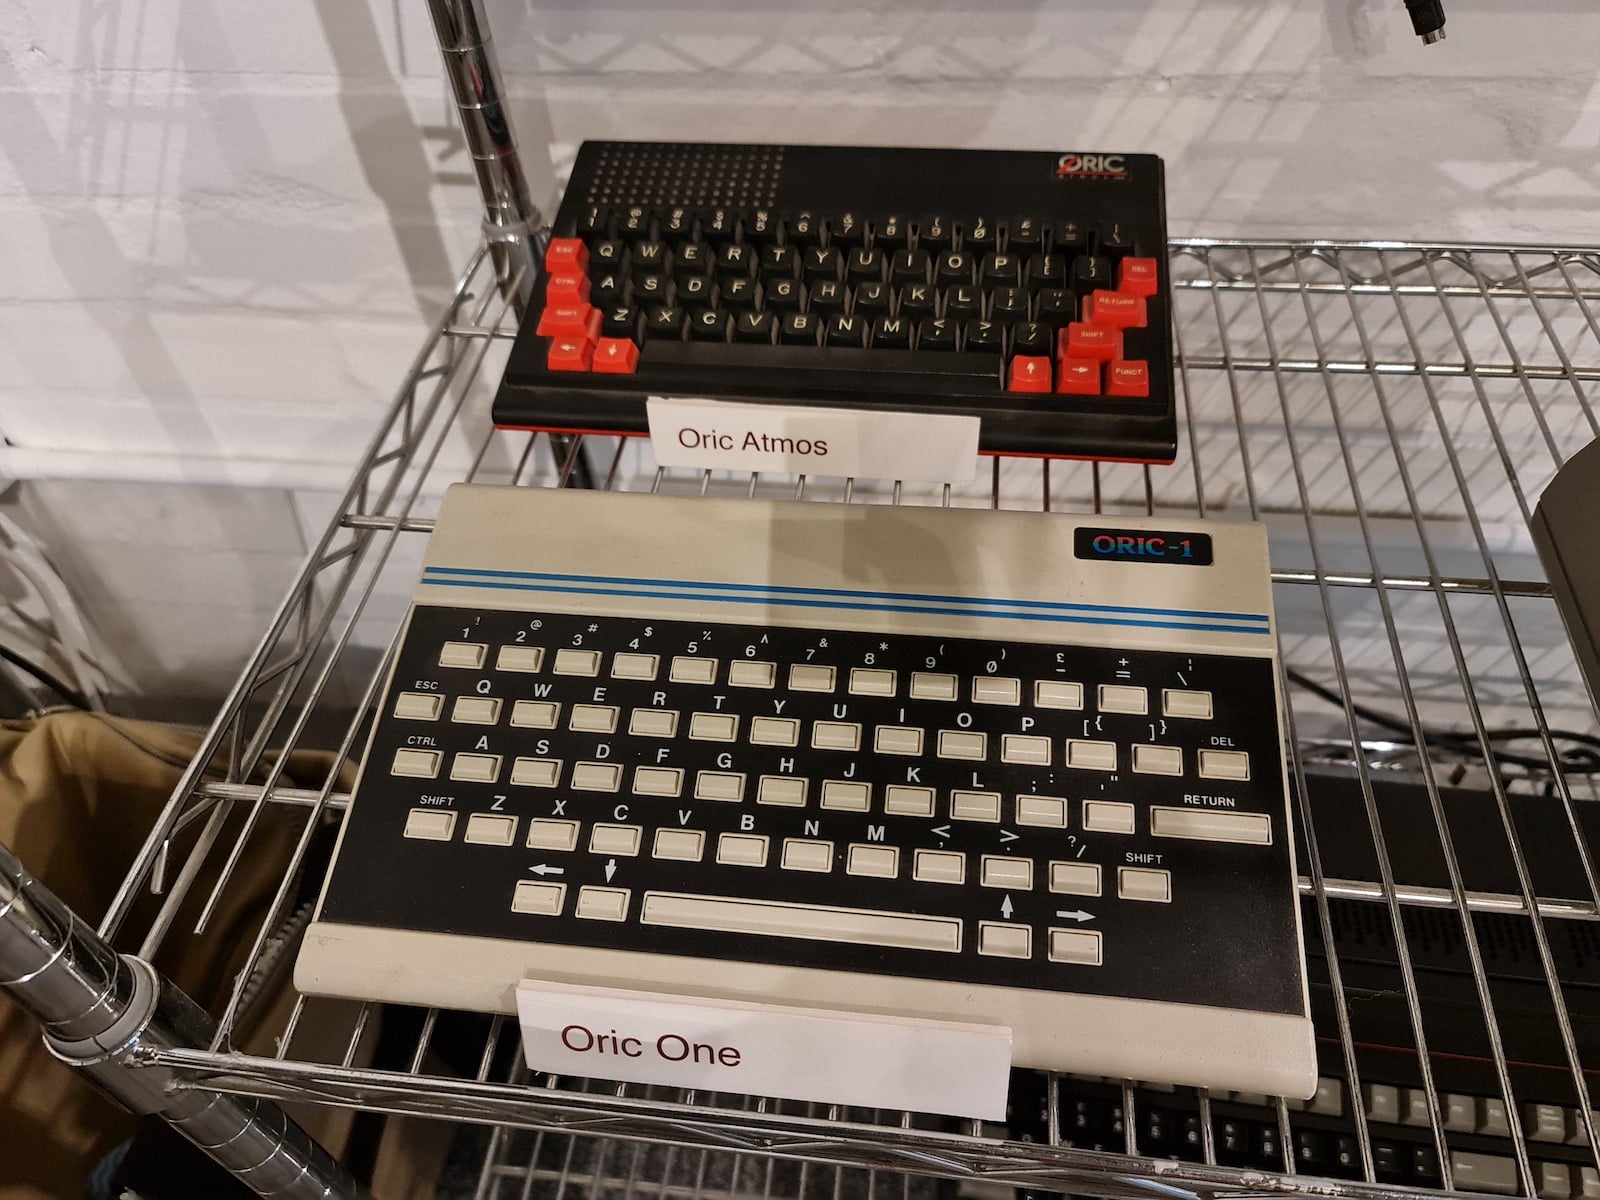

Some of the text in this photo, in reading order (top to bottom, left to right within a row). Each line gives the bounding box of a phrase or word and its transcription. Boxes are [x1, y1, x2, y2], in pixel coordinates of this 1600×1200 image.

[1058, 154, 1126, 173] ORIC
[589, 217, 595, 227] 1
[628, 218, 638, 229] 2
[670, 218, 681, 230] 3
[713, 221, 723, 231] 4
[756, 221, 766, 232] 5
[798, 222, 808, 233] 6
[843, 222, 853, 234] 7
[886, 225, 896, 236] 8
[931, 226, 941, 237] 9
[600, 245, 613, 258] Q
[641, 245, 658, 258] W
[684, 247, 697, 260] E
[728, 248, 741, 260] R
[773, 249, 785, 262] T
[816, 251, 828, 264] Y
[859, 253, 872, 265] U
[907, 255, 912, 267] I
[948, 256, 962, 268] O
[995, 257, 1007, 269] P
[601, 277, 615, 289] A
[644, 278, 658, 290] S
[688, 280, 702, 292] D
[732, 281, 746, 293] F
[777, 283, 790, 295] G
[821, 285, 836, 297] H
[868, 287, 881, 299] J
[912, 288, 925, 301] K
[958, 289, 971, 302] L
[613, 309, 629, 321] Z
[658, 311, 673, 323] X
[702, 313, 717, 325] C
[749, 314, 763, 327] V
[794, 317, 807, 329] B
[838, 318, 853, 330] N
[884, 320, 900, 332] M
[678, 428, 828, 456] Oric Atmos
[1092, 535, 1193, 558] ORIC-1
[462, 627, 470, 639] 1
[515, 631, 526, 642] 2
[572, 634, 583, 646] 3
[628, 638, 640, 650] 4
[687, 641, 698, 653] 5
[745, 645, 756, 657] 6
[805, 649, 816, 660] 7
[864, 653, 875, 665] 8
[925, 657, 936, 668] 9
[475, 616, 481, 626] !
[530, 619, 542, 630] @
[588, 623, 599, 633] #
[644, 626, 653, 637] $
[702, 630, 712, 641] %
[819, 637, 828, 648] &
[939, 644, 945, 655] (
[1001, 648, 1006, 660] )
[1118, 657, 1129, 667] +
[415, 680, 438, 690] ESC
[476, 679, 492, 694] Q
[533, 683, 552, 698] W
[593, 687, 607, 702] E
[652, 691, 667, 705] R
[713, 696, 726, 710] T
[773, 700, 786, 714] Y
[833, 704, 847, 719] U
[899, 708, 905, 722] I
[956, 712, 973, 727] O
[1021, 717, 1035, 731] P
[1211, 736, 1235, 747] DEL
[407, 735, 437, 746] CTRL
[475, 735, 489, 750] A
[536, 740, 550, 755] S
[595, 744, 610, 759] D
[656, 749, 670, 764] F
[716, 753, 732, 768] G
[779, 758, 794, 773] H
[844, 762, 856, 777] J
[907, 767, 921, 782] K
[972, 772, 985, 787] L
[1184, 795, 1235, 807] RETURN
[420, 795, 455, 807] SHIFT
[490, 796, 506, 810] Z
[552, 800, 567, 815] X
[614, 805, 629, 820] C
[679, 810, 693, 825] V
[740, 815, 755, 830] B
[804, 820, 820, 836] N
[867, 825, 885, 841] M
[1126, 852, 1164, 865] SHIFT
[561, 1025, 741, 1067] Oric One
